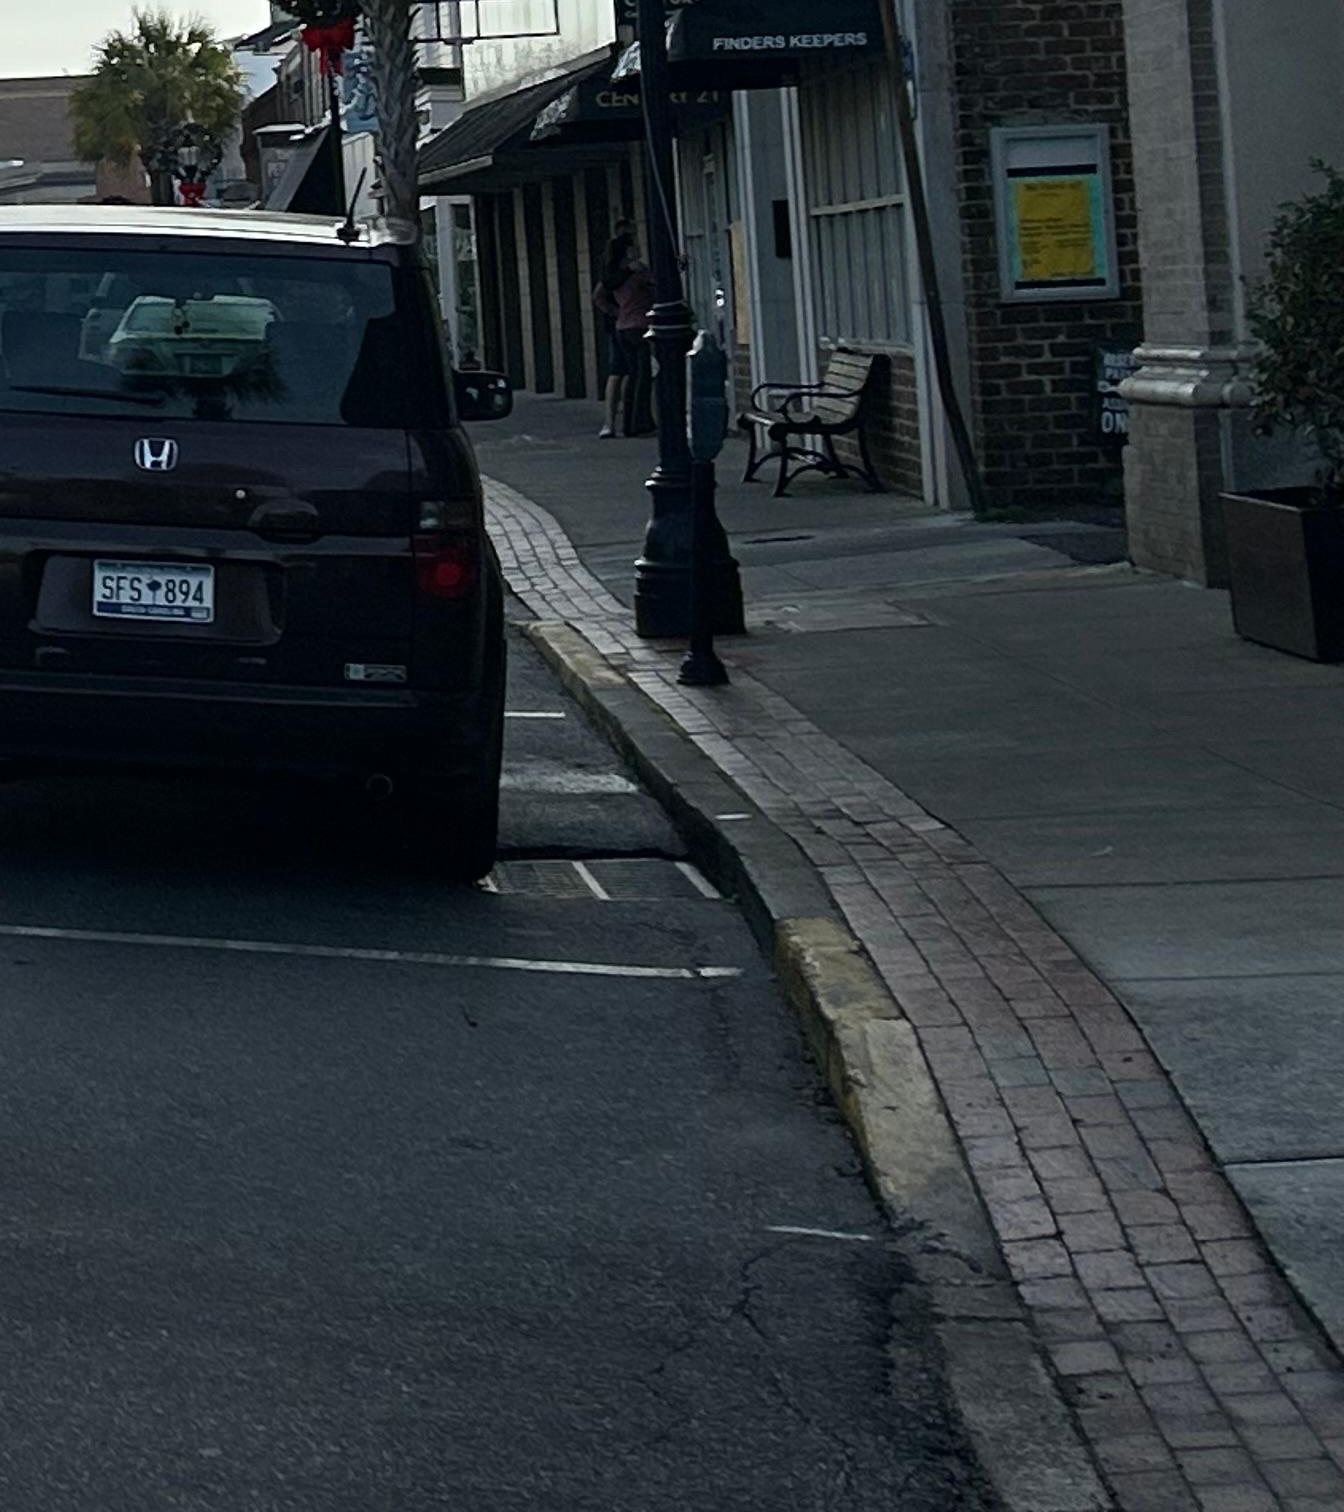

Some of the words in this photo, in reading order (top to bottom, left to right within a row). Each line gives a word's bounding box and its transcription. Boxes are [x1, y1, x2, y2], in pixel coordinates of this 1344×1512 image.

[712, 37, 787, 51] FINDERS
[789, 32, 868, 48] KEEPERS
[102, 575, 143, 602] SFS
[164, 579, 205, 605] 894
